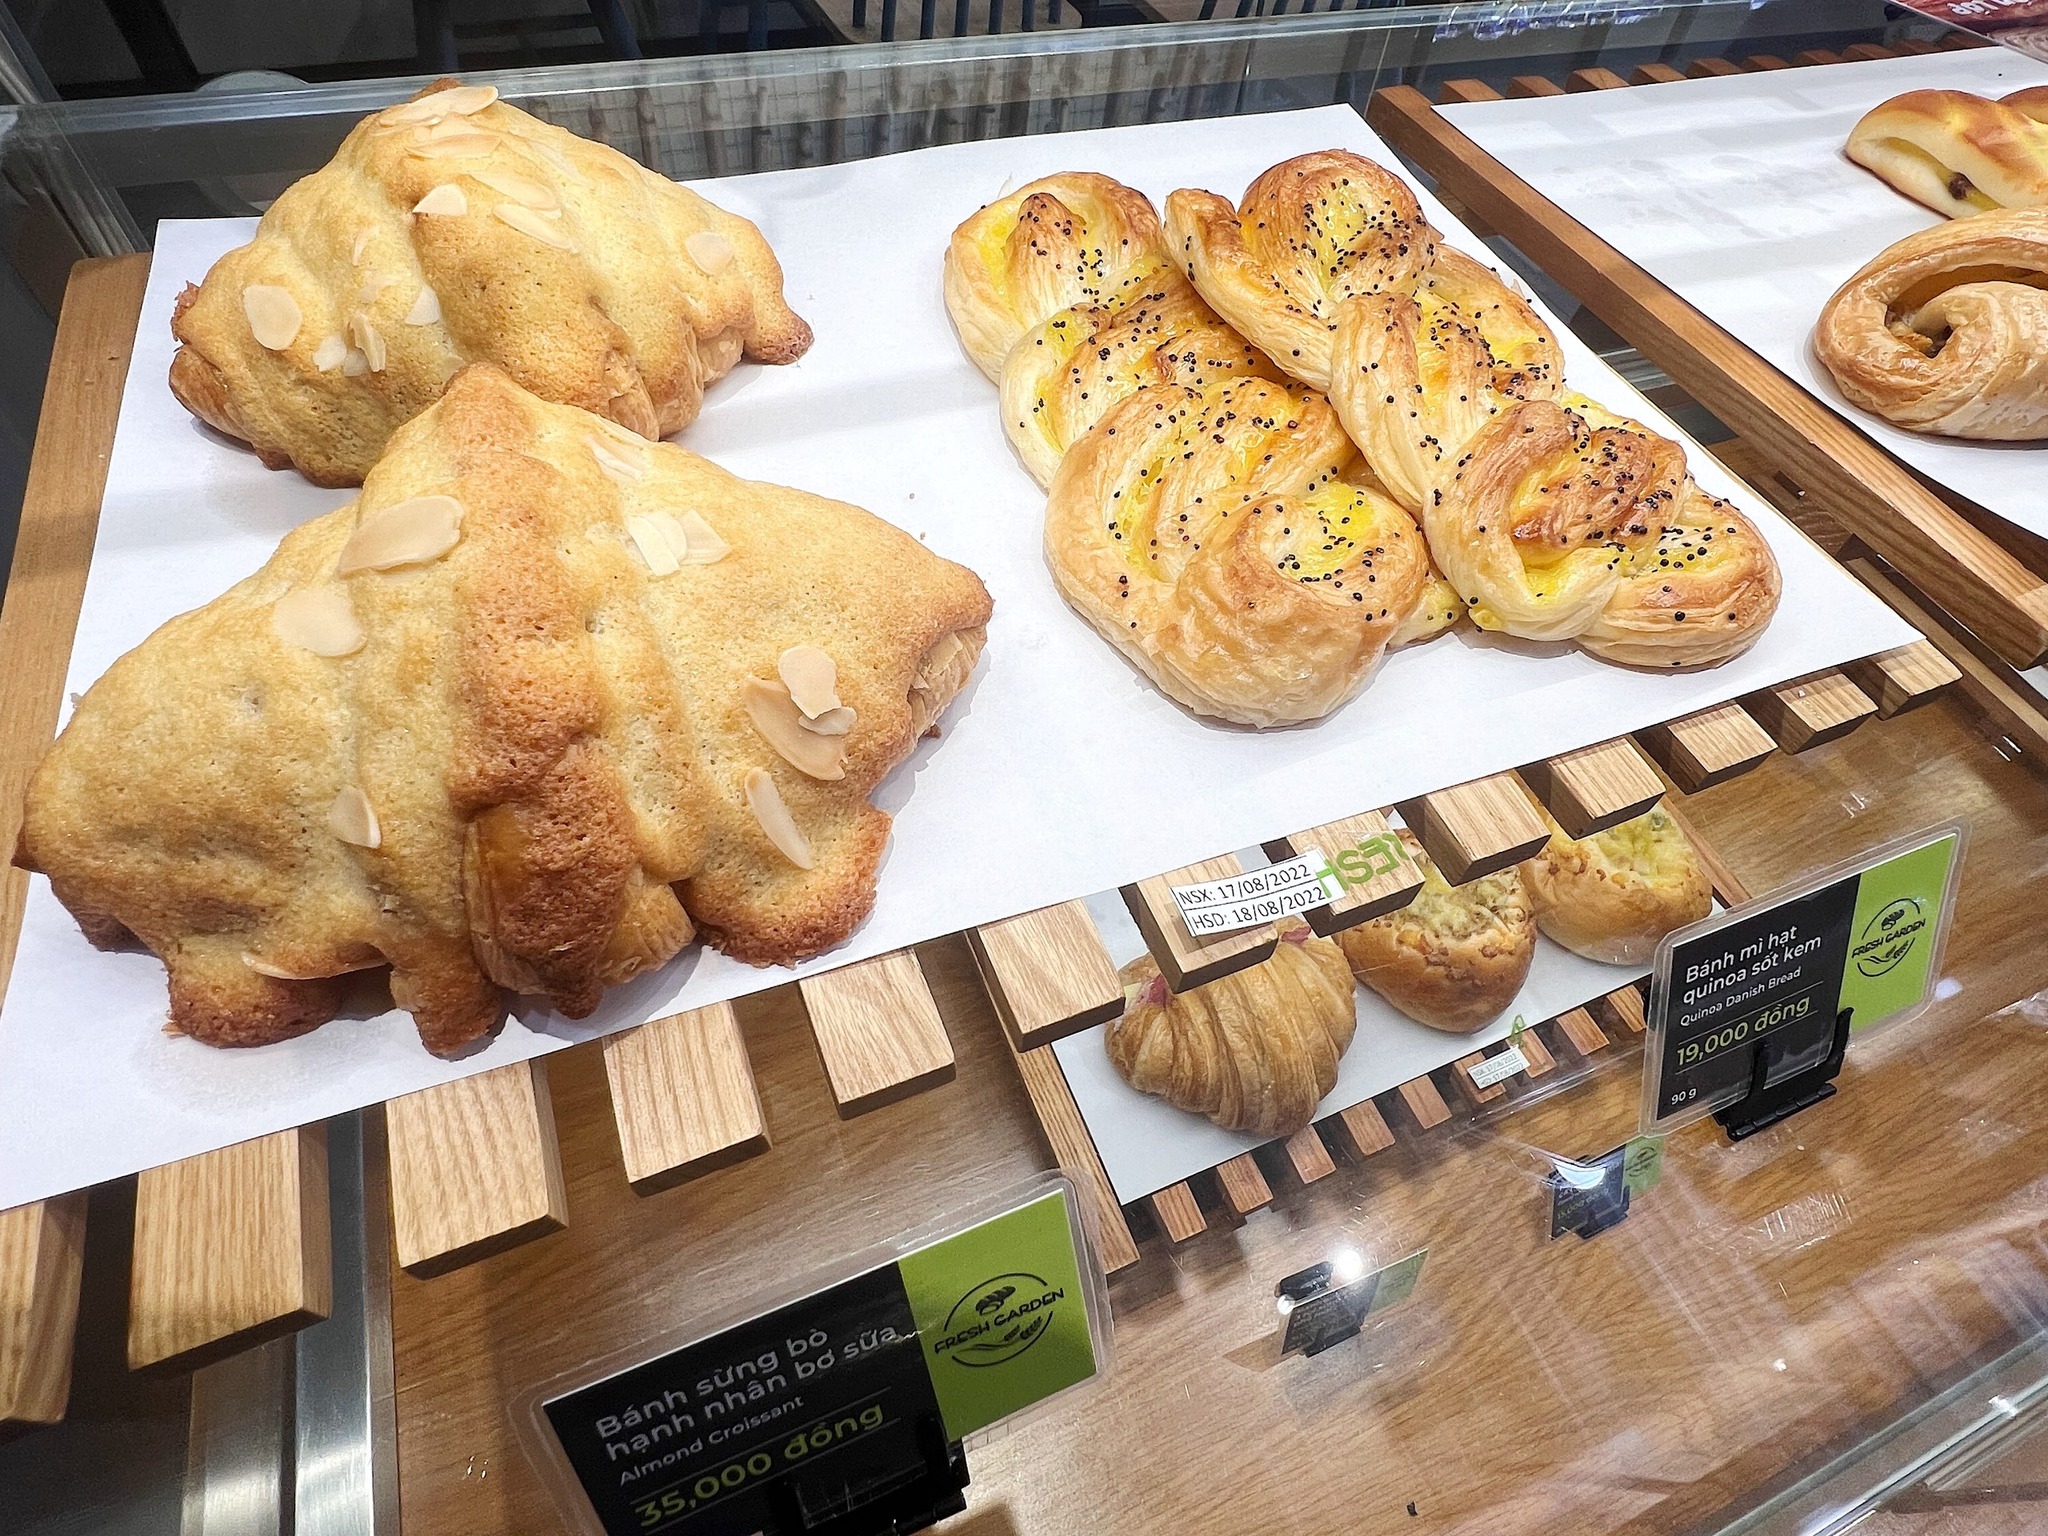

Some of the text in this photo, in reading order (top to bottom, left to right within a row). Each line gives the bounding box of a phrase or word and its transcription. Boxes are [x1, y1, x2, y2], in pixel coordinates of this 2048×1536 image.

[1178, 864, 1312, 906] NSX: 17/08/2022
[1192, 886, 1326, 930] HSD: 18/08/2022
[1683, 936, 1822, 1005] quinoa sốt kem
[1685, 925, 1798, 984] Bánh mì hạt
[1851, 918, 1926, 958] FRESH GARDEN
[1680, 967, 1801, 1027] Quinoa Danish Bread
[1677, 996, 1810, 1066] 19,000 đồng
[1671, 1088, 1697, 1105] 90 g
[934, 1288, 1064, 1354] FRESH GARDEN
[596, 1328, 828, 1438] Bánh sừng bò
[606, 1326, 897, 1461] hạnh nhân bơ sữa
[620, 1396, 805, 1487] Almond Croissant
[635, 1453, 772, 1527] 35,000
